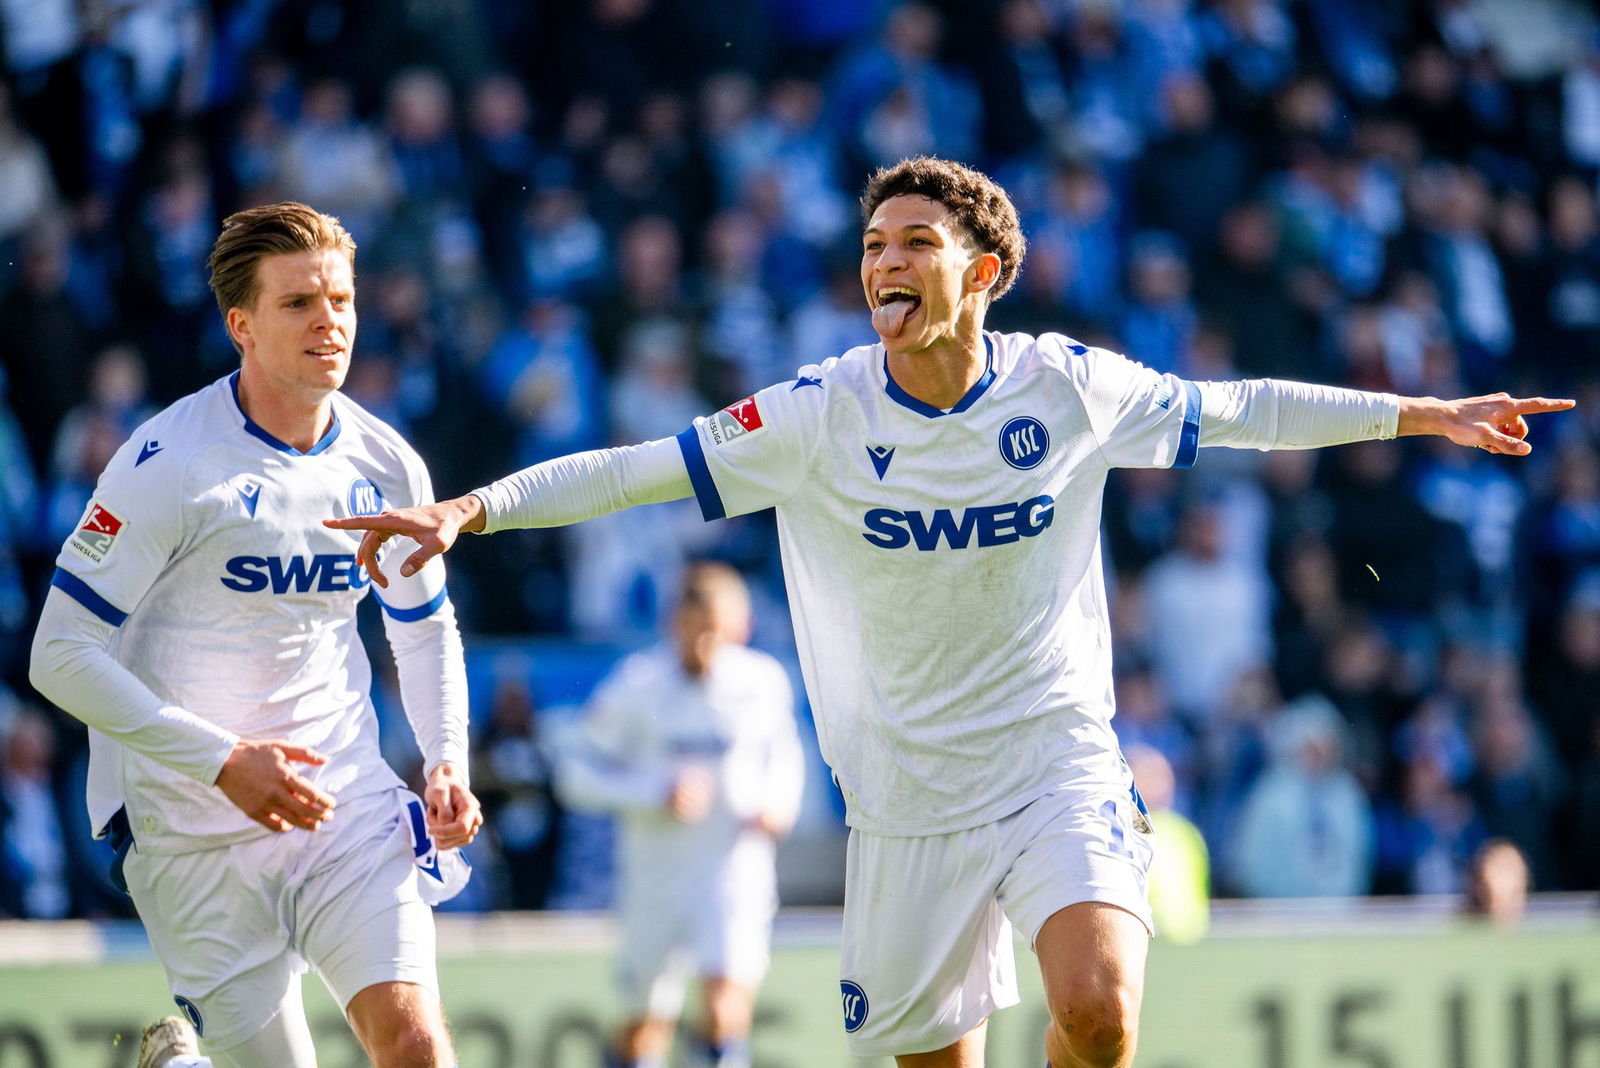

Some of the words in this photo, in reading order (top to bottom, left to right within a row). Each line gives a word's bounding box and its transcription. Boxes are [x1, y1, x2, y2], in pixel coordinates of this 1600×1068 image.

[1009, 424, 1040, 460] KSC
[355, 485, 378, 514] KSC
[862, 494, 1055, 551] SWEG
[70, 538, 101, 564] NDESLIGA
[842, 992, 861, 1022] SC
